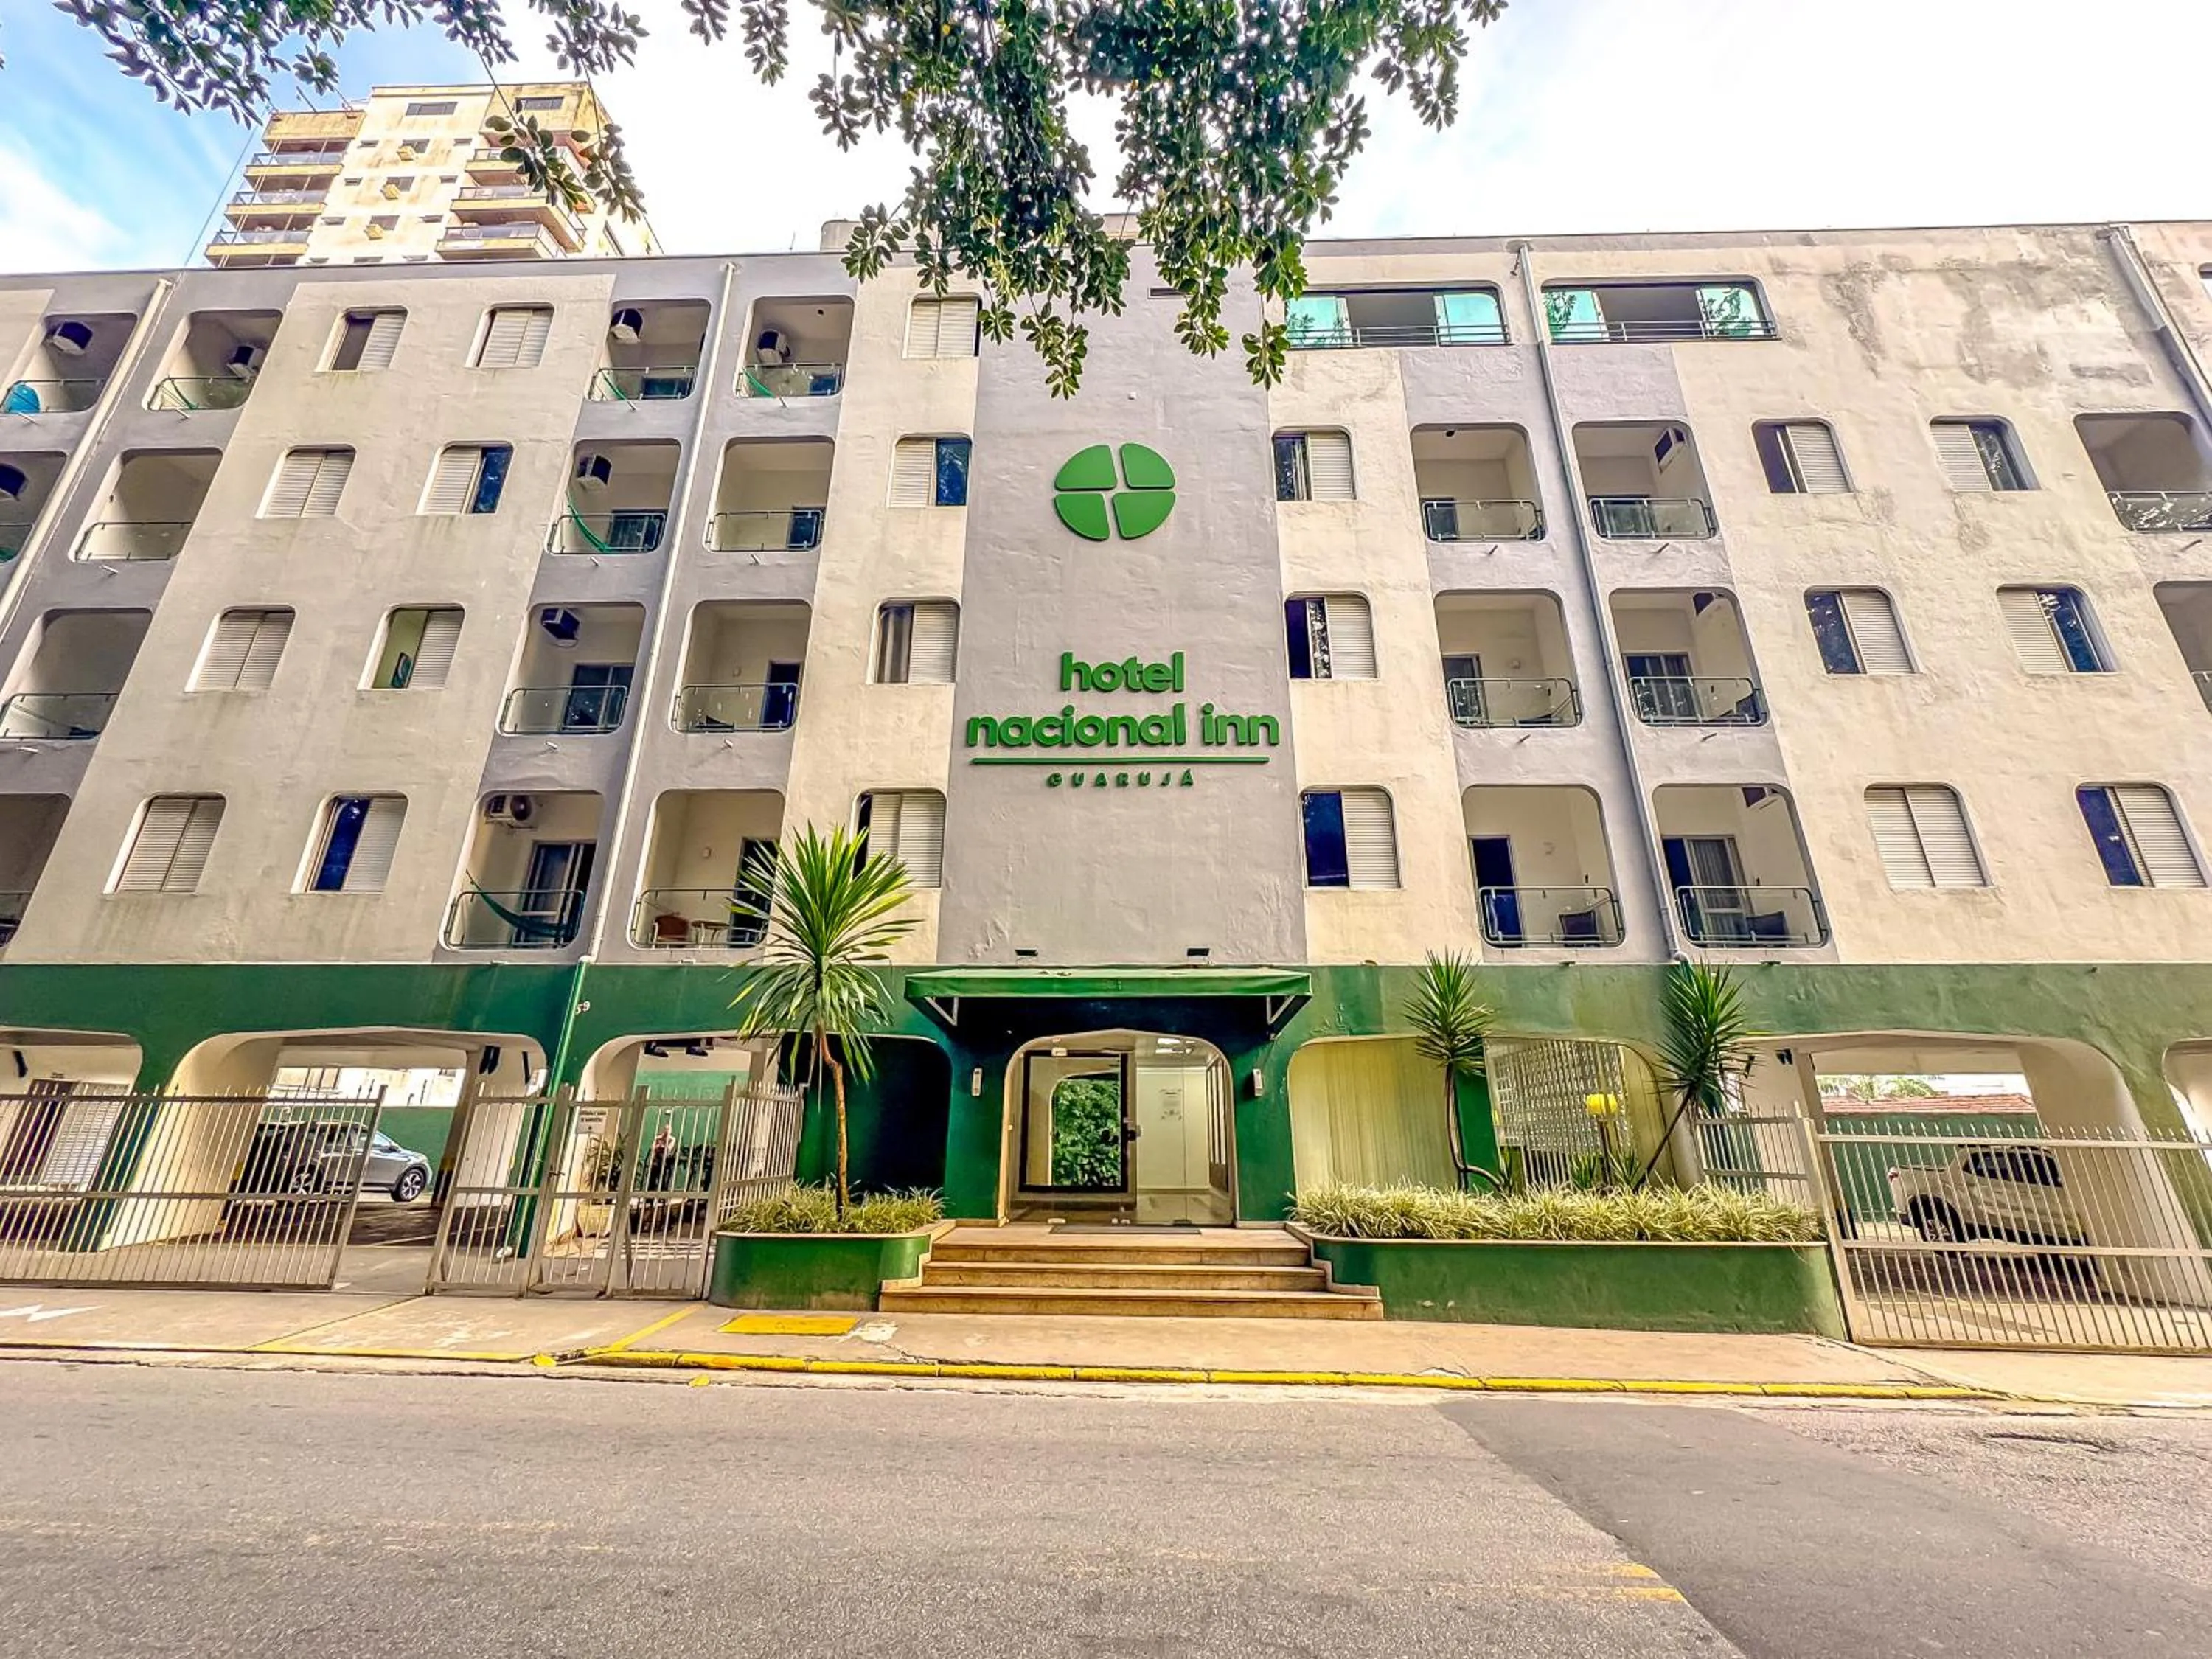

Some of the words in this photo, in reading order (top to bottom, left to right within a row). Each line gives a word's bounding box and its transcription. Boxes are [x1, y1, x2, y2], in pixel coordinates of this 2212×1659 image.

[1060, 651, 1184, 692] hotel
[967, 703, 1185, 747] nacional
[1202, 703, 1280, 745] inn
[1046, 768, 1194, 787] GUARUJÁ
